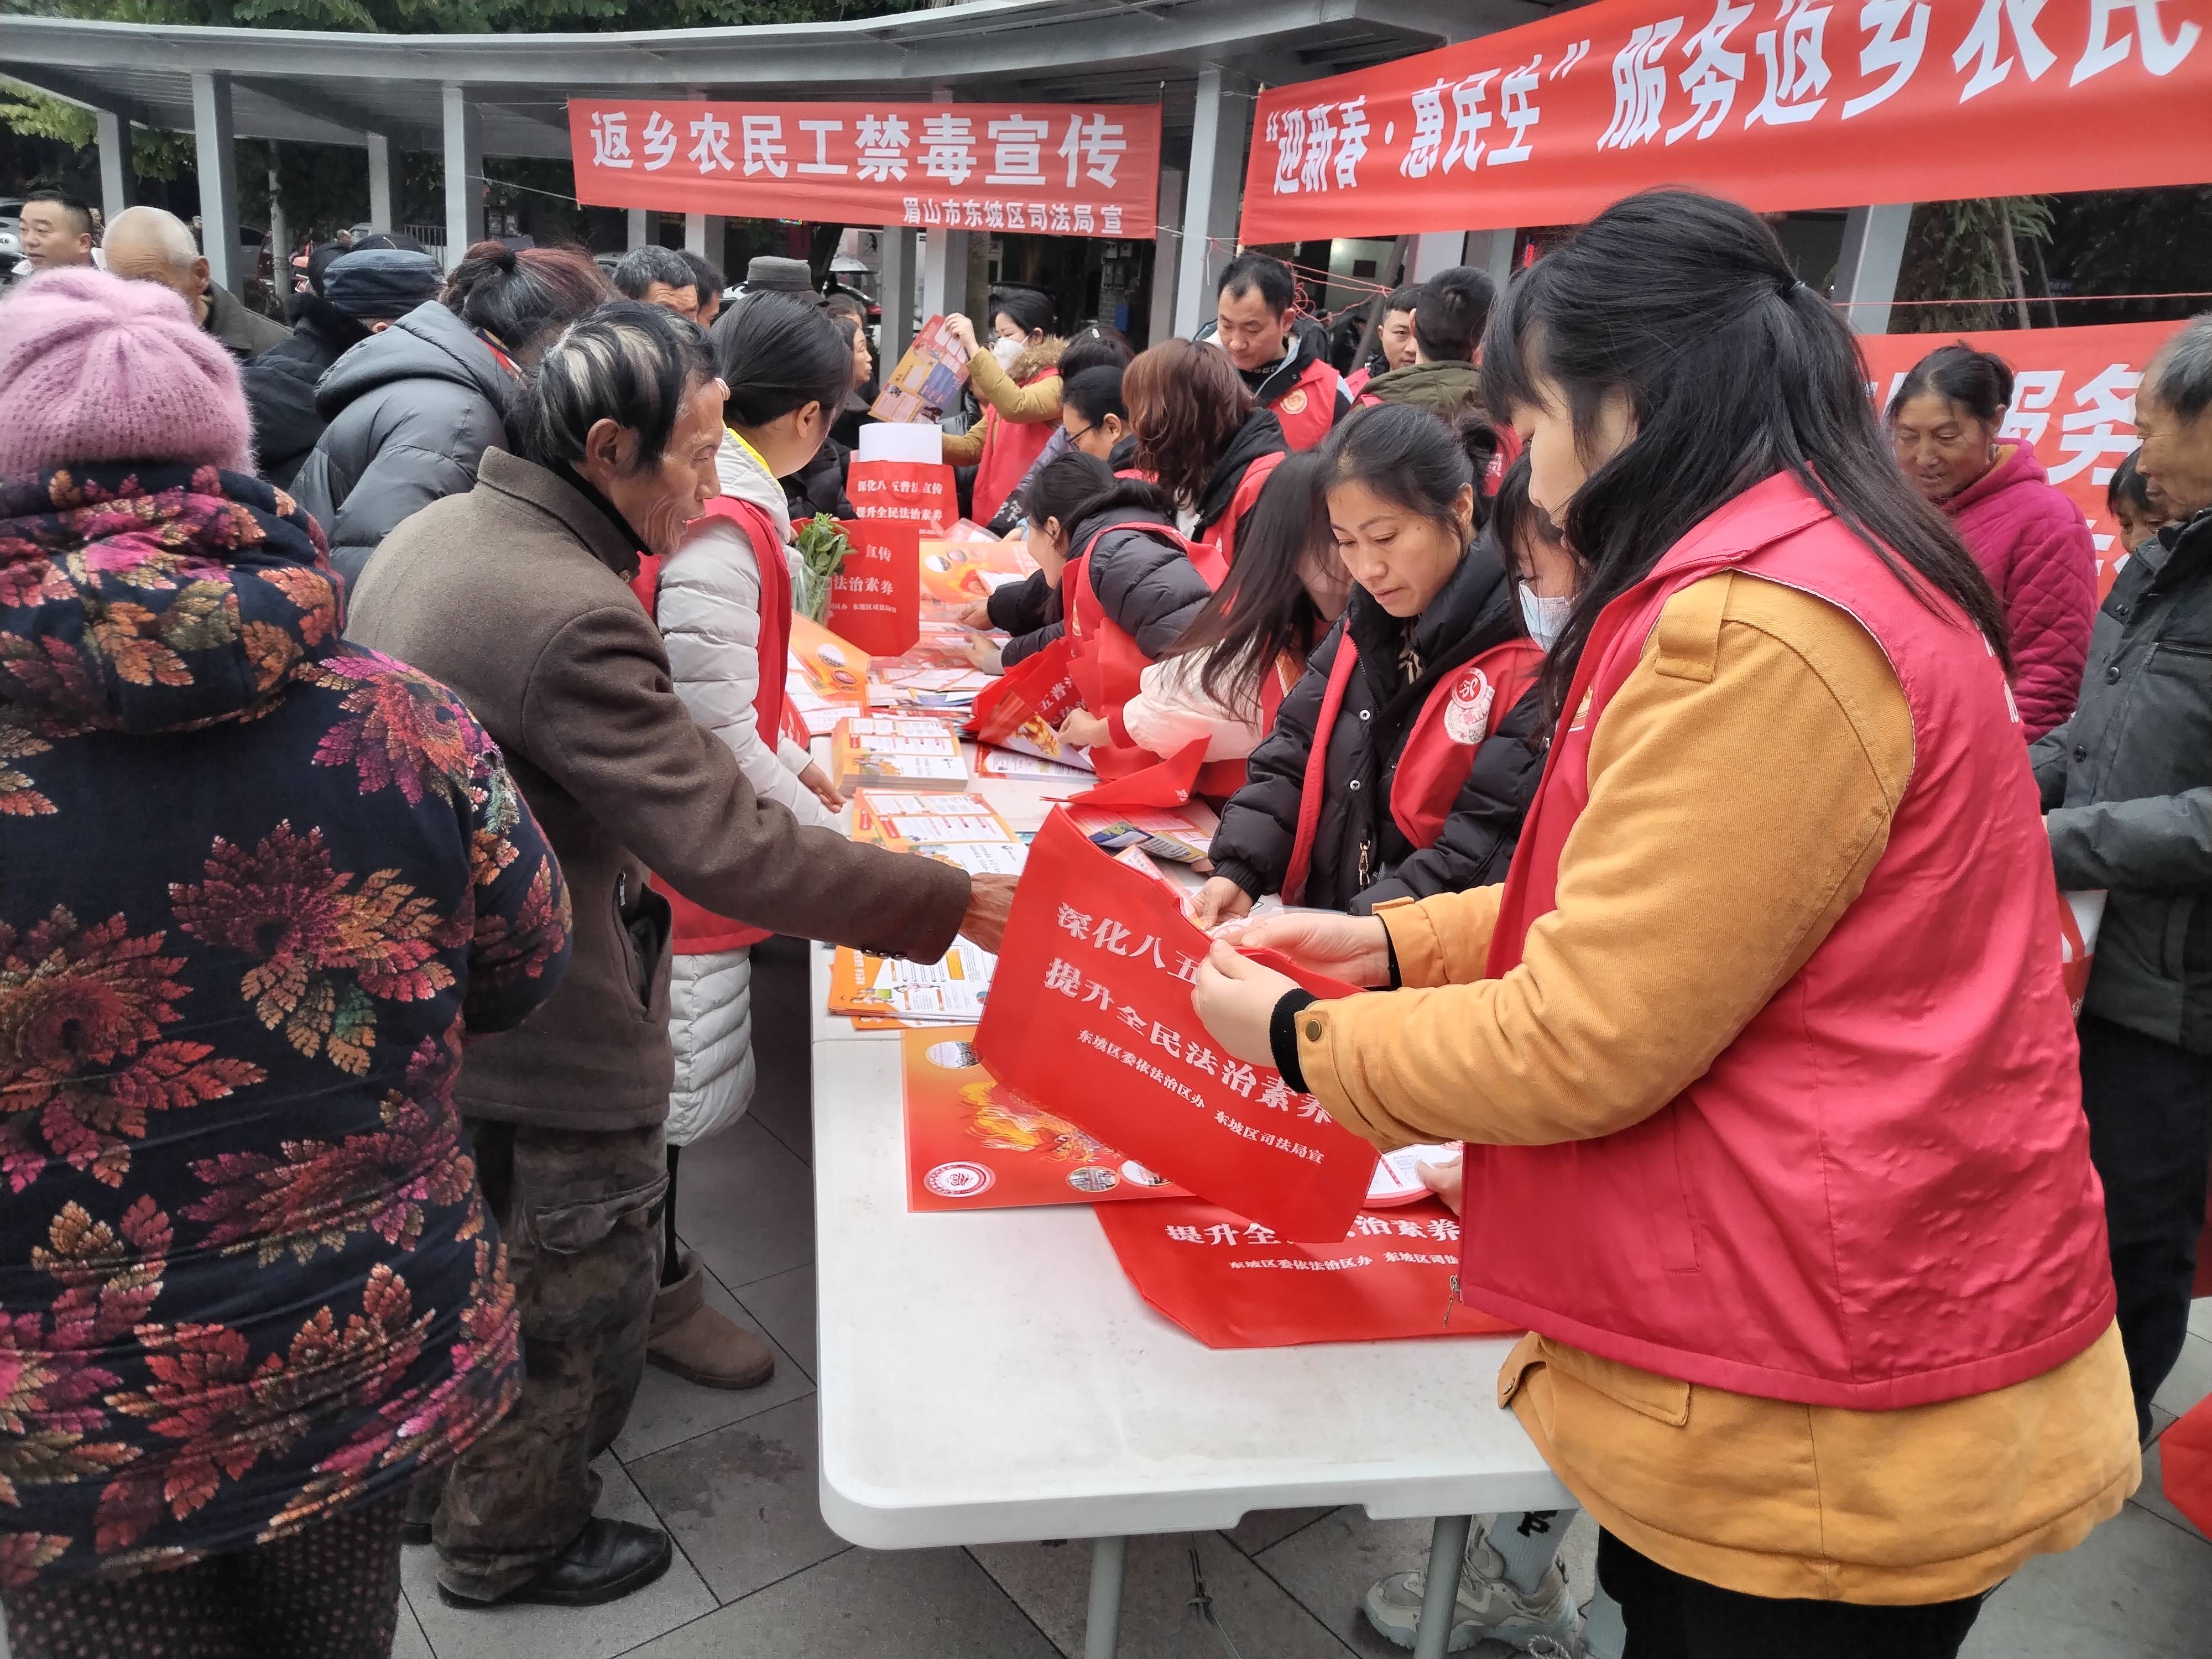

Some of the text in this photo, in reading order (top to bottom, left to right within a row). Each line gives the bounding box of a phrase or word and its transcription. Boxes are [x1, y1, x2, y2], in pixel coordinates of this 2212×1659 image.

[590, 111, 1127, 189] 返乡农民工禁毒宣传
[1043, 957, 1333, 1125] 提升全民法治素养
[1077, 1029, 1326, 1165] 东坡区委依法治区办 东坡区司法局宣
